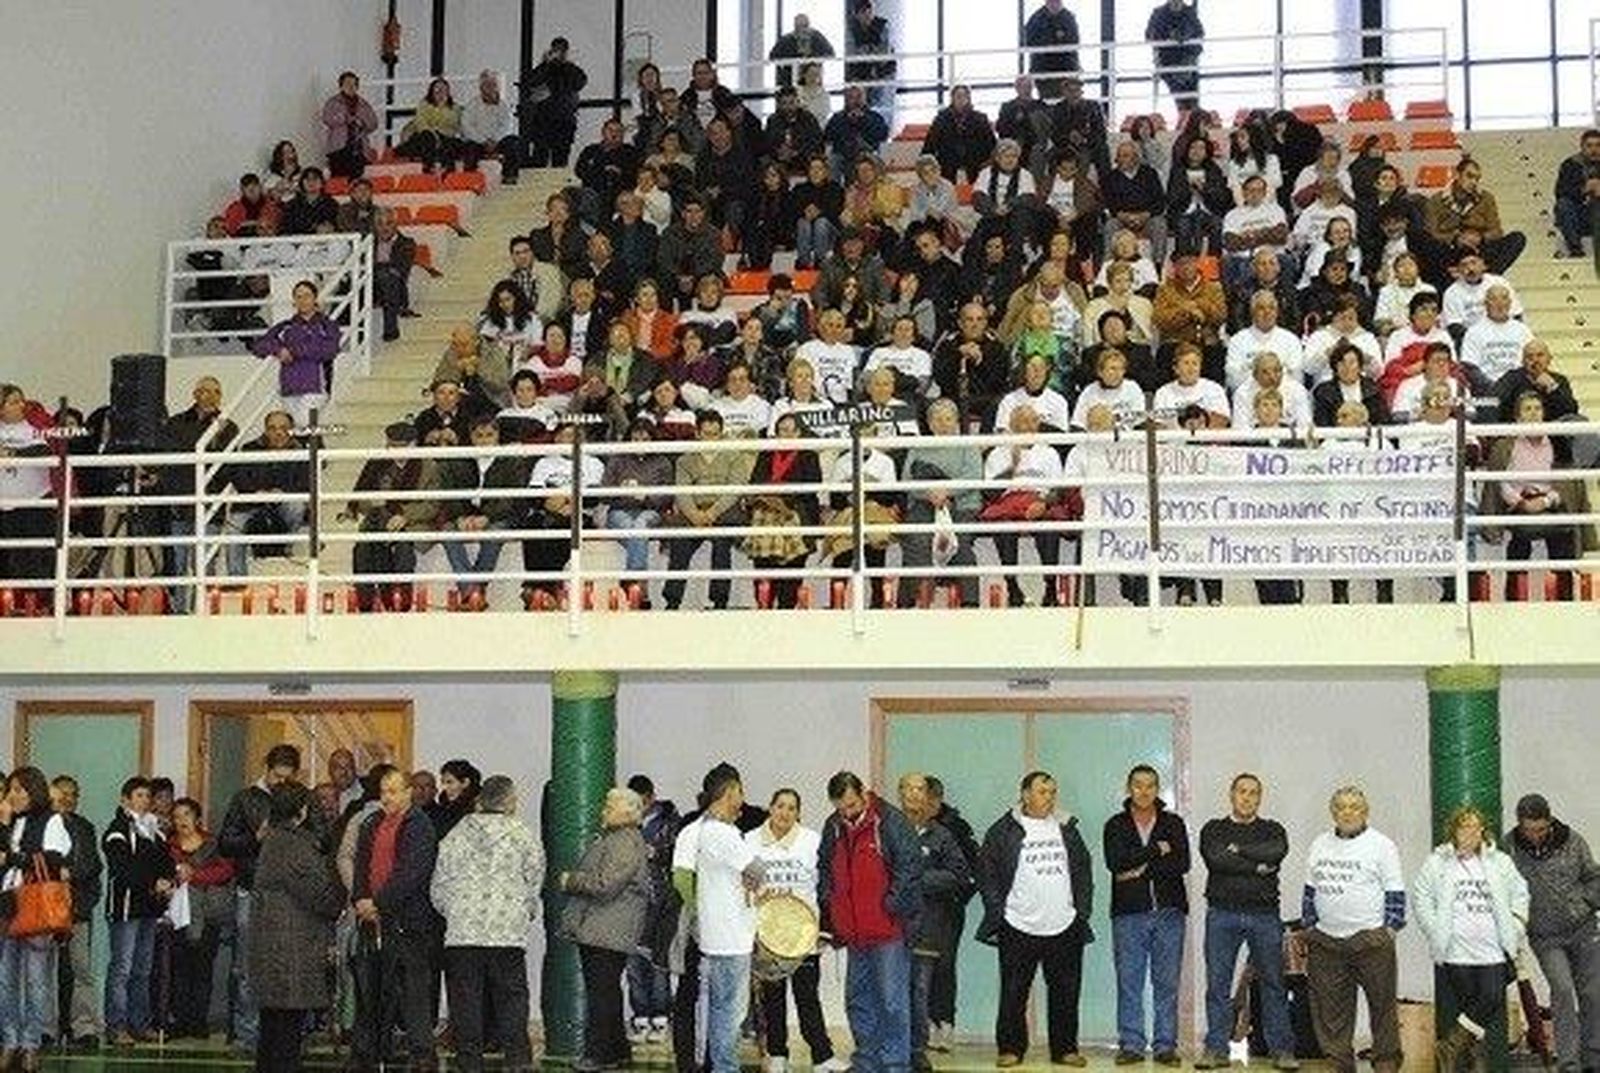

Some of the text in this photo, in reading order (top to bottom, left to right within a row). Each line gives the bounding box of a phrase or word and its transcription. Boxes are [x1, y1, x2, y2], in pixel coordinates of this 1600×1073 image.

[801, 406, 894, 426] VILLARINO
[1105, 447, 1209, 474] VILLRINO
[1246, 453, 1288, 475] NO
[1142, 499, 1208, 520] OMOS
